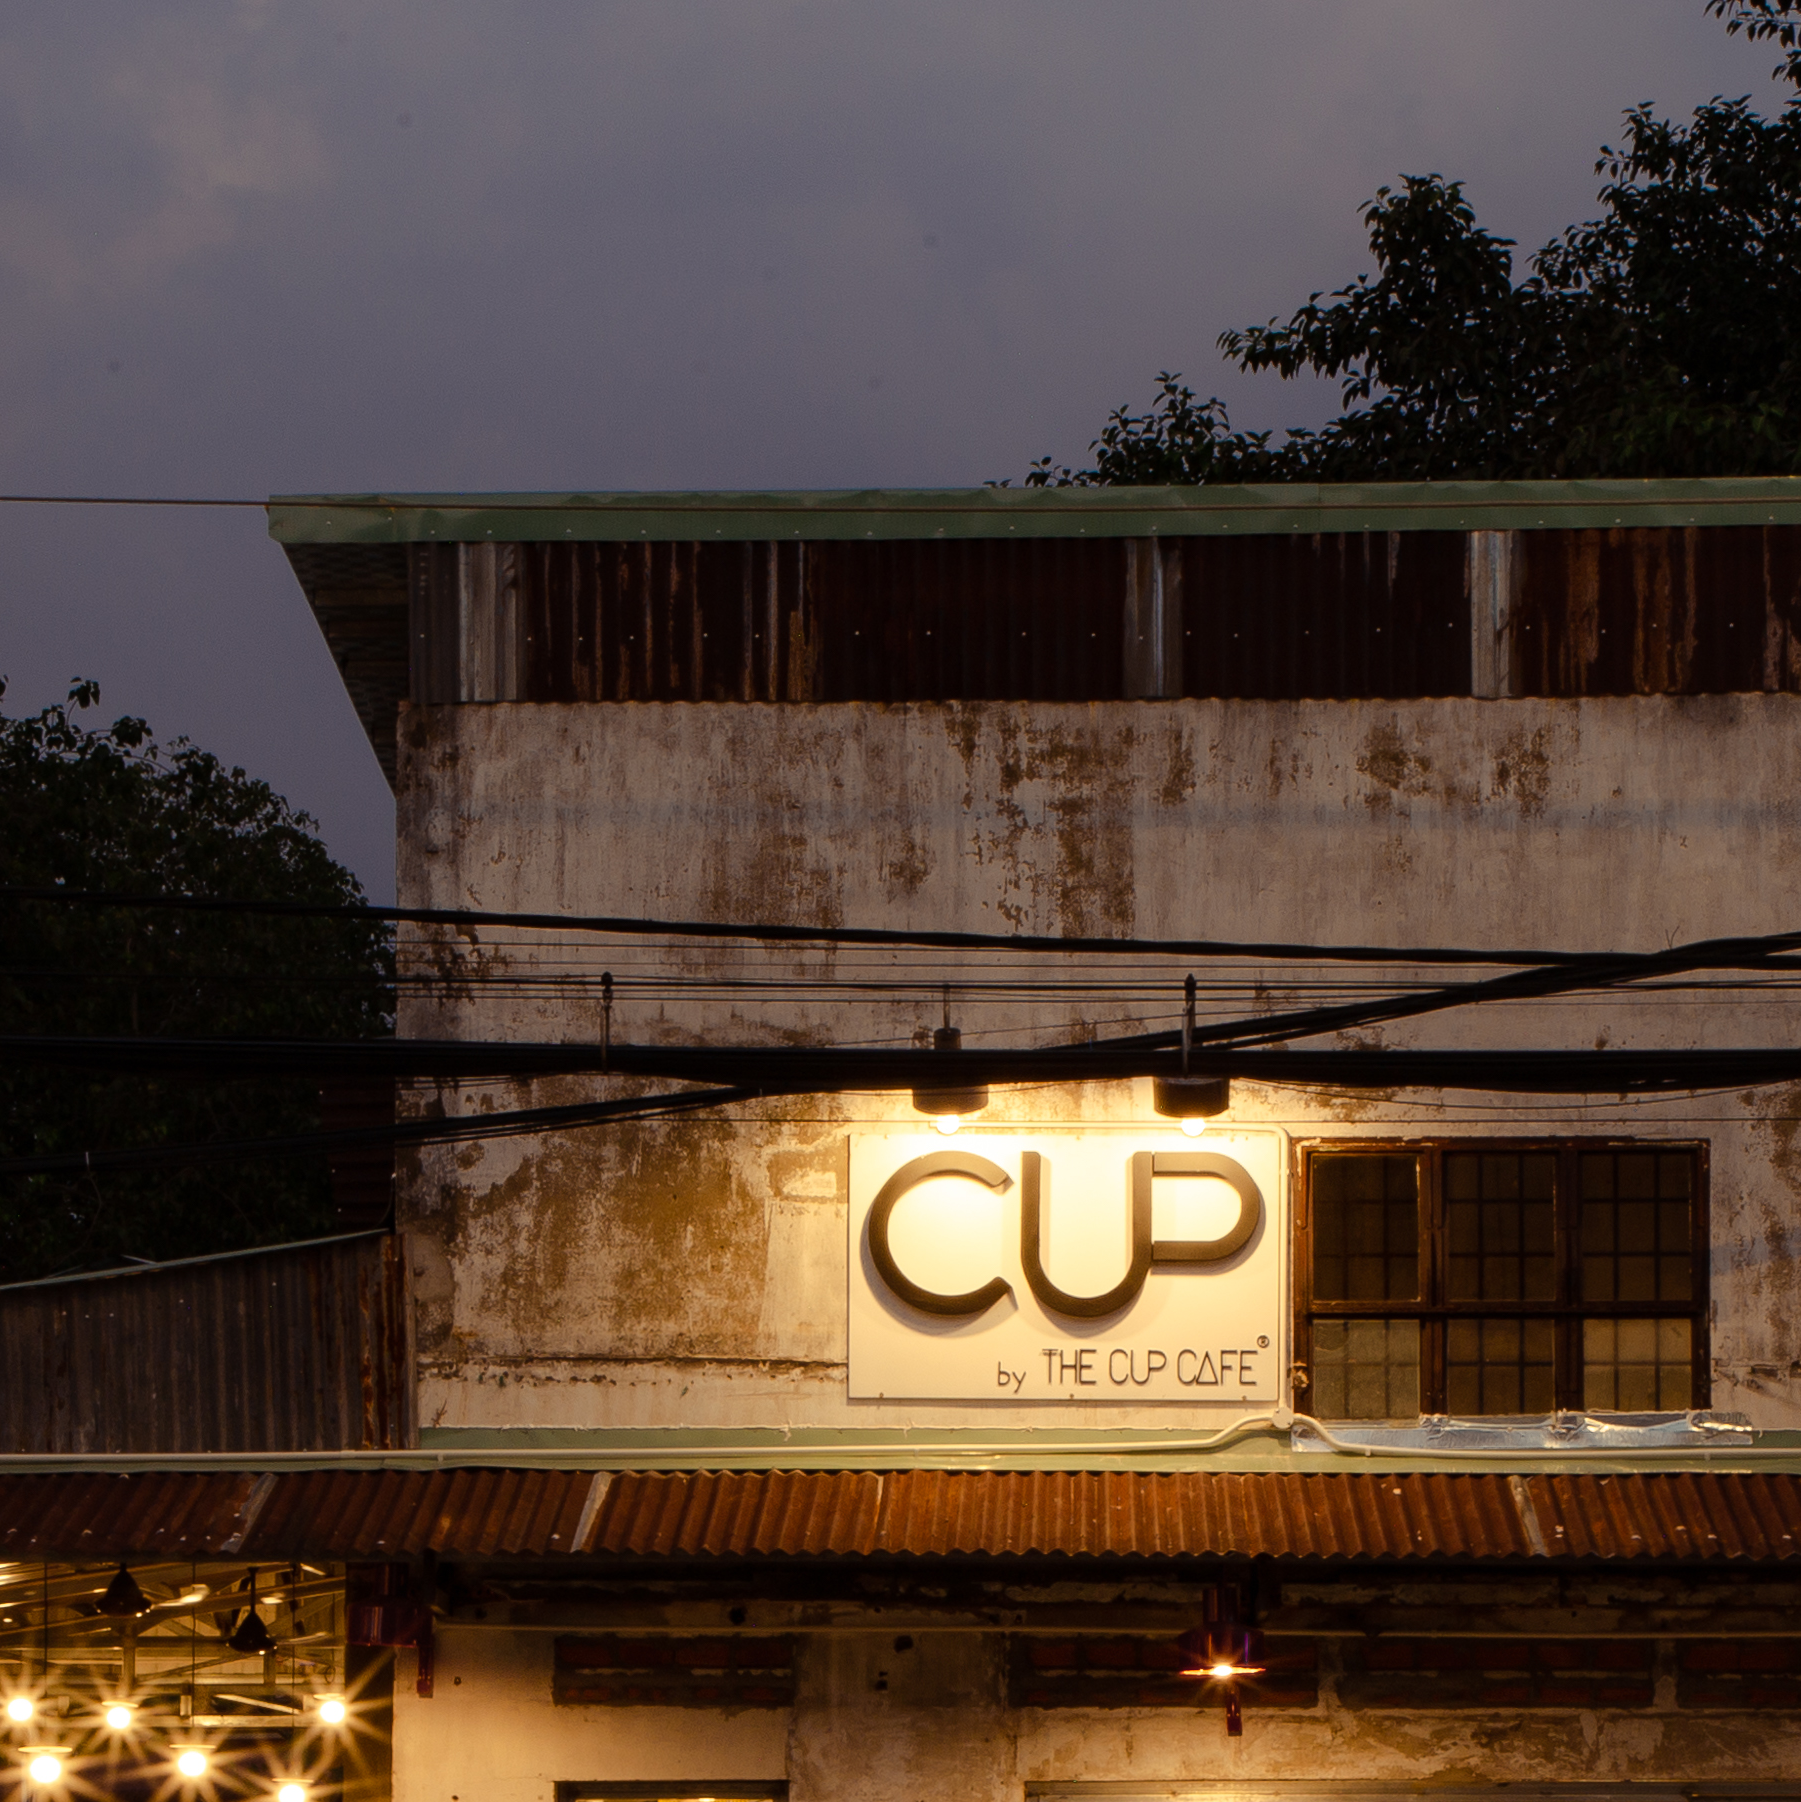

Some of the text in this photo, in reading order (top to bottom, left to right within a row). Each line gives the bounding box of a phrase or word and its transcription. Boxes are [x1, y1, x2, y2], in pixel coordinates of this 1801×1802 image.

[867, 1150, 1262, 1319] CUP
[997, 1361, 1027, 1393] by
[1041, 1348, 1097, 1386] THE
[1108, 1348, 1167, 1387] CUP
